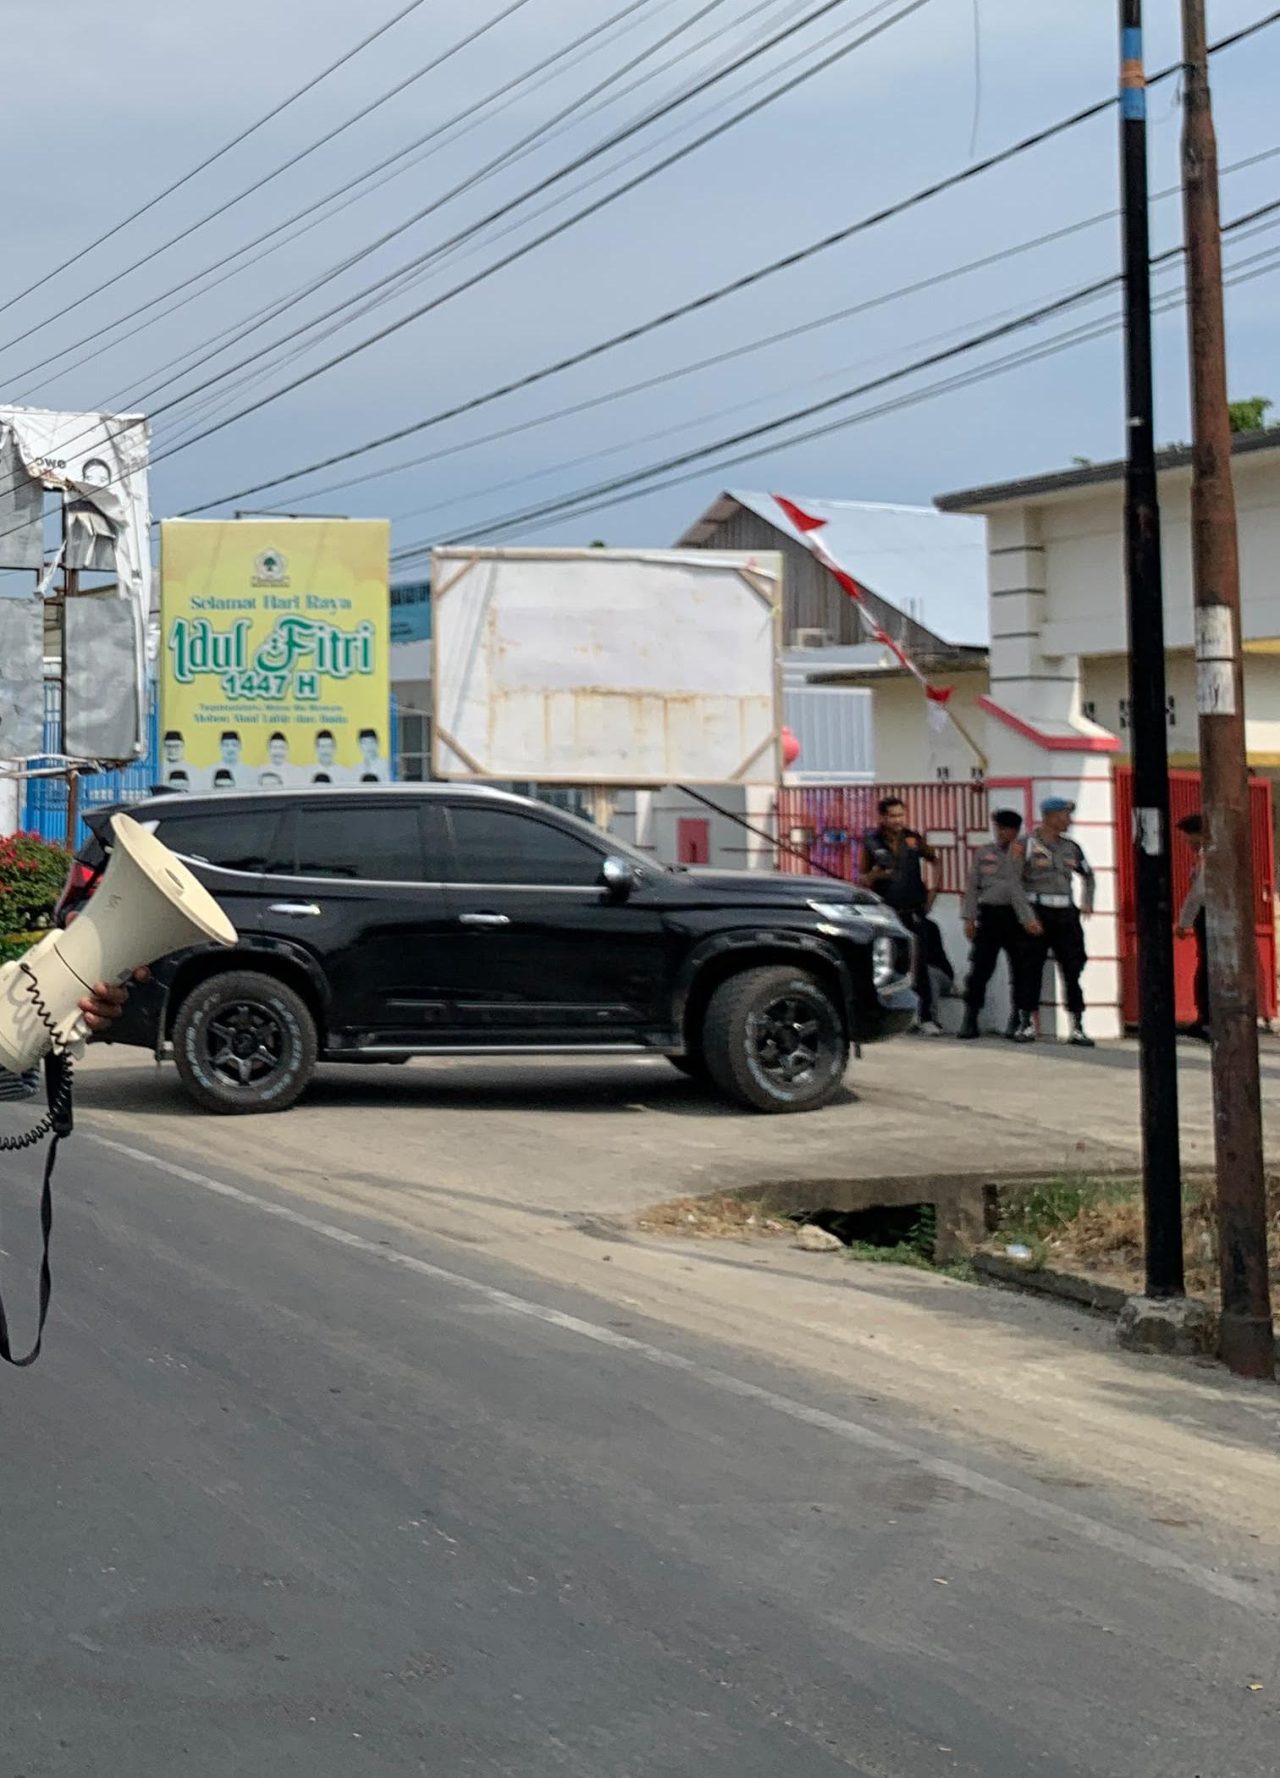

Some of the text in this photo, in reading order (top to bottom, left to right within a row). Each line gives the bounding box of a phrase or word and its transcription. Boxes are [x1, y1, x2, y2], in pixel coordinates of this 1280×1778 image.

[191, 595, 352, 615] Selamat Hari Raya
[169, 614, 375, 682] Idul Fitri
[222, 673, 320, 698] 1447 H
